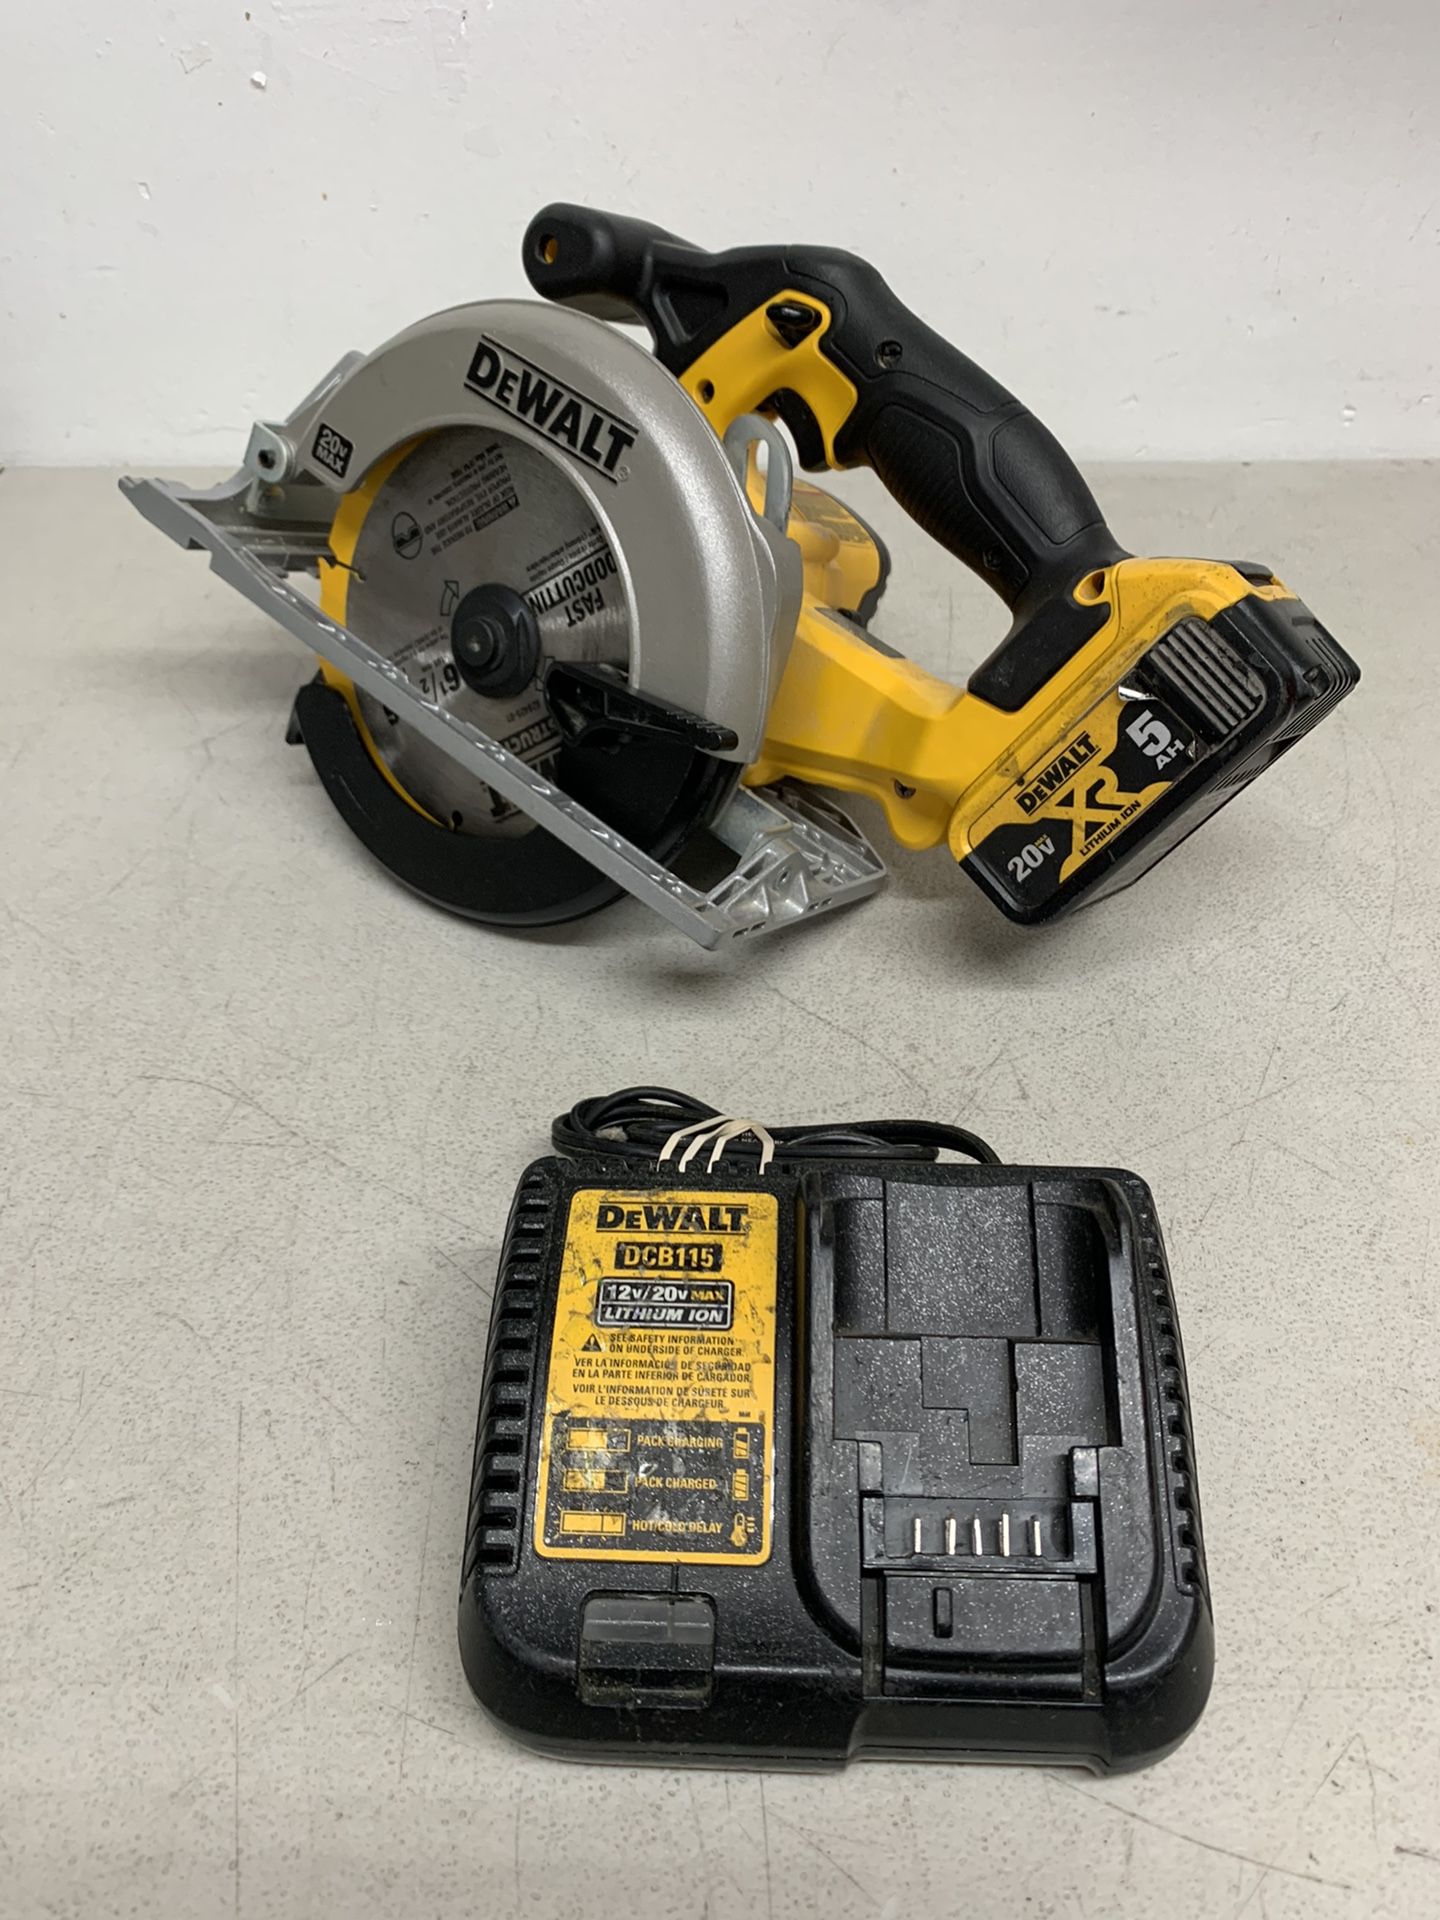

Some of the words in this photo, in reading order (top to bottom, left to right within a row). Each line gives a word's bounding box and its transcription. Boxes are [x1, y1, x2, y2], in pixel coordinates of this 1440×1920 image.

[466, 342, 635, 472] DEWALT
[315, 446, 345, 473] MAX
[524, 552, 617, 616] OODCUTTIN
[567, 587, 605, 628] FAST
[504, 719, 557, 754] STRUCT
[1125, 709, 1172, 757] 5
[1154, 739, 1185, 770] AH
[1016, 733, 1096, 815] DEWALT
[1079, 818, 1122, 856] LITHIUM
[1120, 800, 1142, 820] ION
[597, 1204, 749, 1232] DEWALT
[624, 1246, 714, 1267] DCB115
[691, 1289, 725, 1302] MAX
[603, 1308, 683, 1321] LITHIUM
[688, 1310, 723, 1323] ION
[609, 1333, 630, 1342] SEE
[630, 1334, 666, 1344] SAFETY
[667, 1335, 735, 1346] INFORMATION
[609, 1343, 623, 1353] ON
[626, 1344, 681, 1355] UNDERSIDE
[683, 1346, 696, 1355] OF
[575, 1358, 592, 1367] VER
[595, 1358, 607, 1368] LA
[681, 1360, 693, 1370] DE
[572, 1369, 584, 1378] EN
[588, 1369, 600, 1379] LA
[602, 1370, 633, 1380] PARTE
[635, 1371, 679, 1382] INFERIOR
[681, 1372, 694, 1381] DE
[572, 1383, 595, 1393] VOIR
[598, 1384, 673, 1396] L'INFORMATION
[676, 1386, 689, 1396] DE
[731, 1388, 751, 1399] SUR
[595, 1396, 605, 1406] LE
[608, 1396, 653, 1407] DESSOUS
[656, 1398, 669, 1407] DE
[637, 1435, 665, 1447] PACK
[667, 1435, 723, 1448] CHARGING
[634, 1477, 663, 1488] PACK
[665, 1477, 717, 1490] CHARGED
[689, 1521, 723, 1535] DELAY
